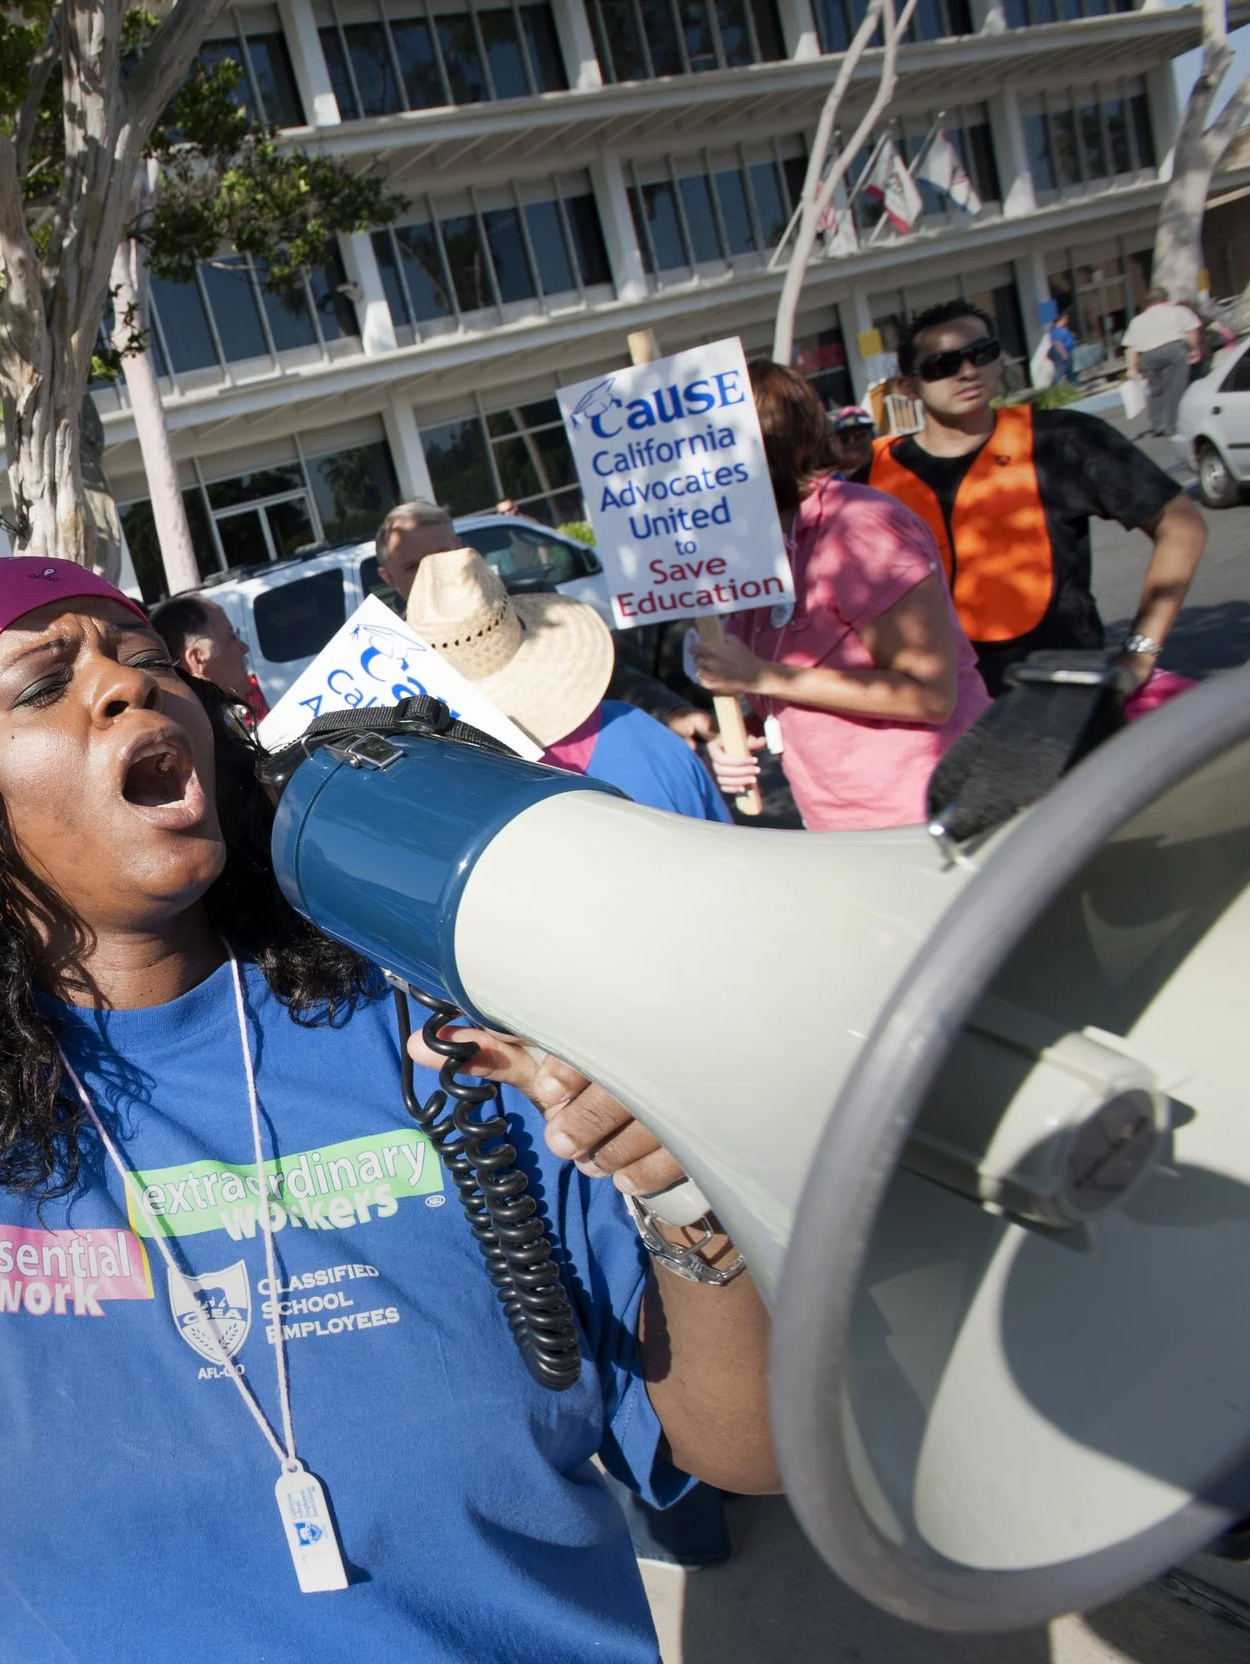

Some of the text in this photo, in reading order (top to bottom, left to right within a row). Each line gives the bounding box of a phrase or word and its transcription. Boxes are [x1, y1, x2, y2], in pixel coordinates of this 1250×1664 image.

[592, 425, 736, 477] California
[600, 461, 749, 512] Advocates
[629, 497, 732, 540] United
[675, 539, 697, 556] to
[650, 556, 727, 585] Save
[616, 576, 785, 617] Education
[142, 1141, 427, 1217] extraordinary
[220, 1183, 398, 1242] workers
[257, 1264, 379, 1295] CLASSIFIED
[261, 1291, 354, 1320] SCHOOL
[265, 1306, 400, 1345] EMPLOYEES
[198, 1363, 245, 1380] AFL-CO
